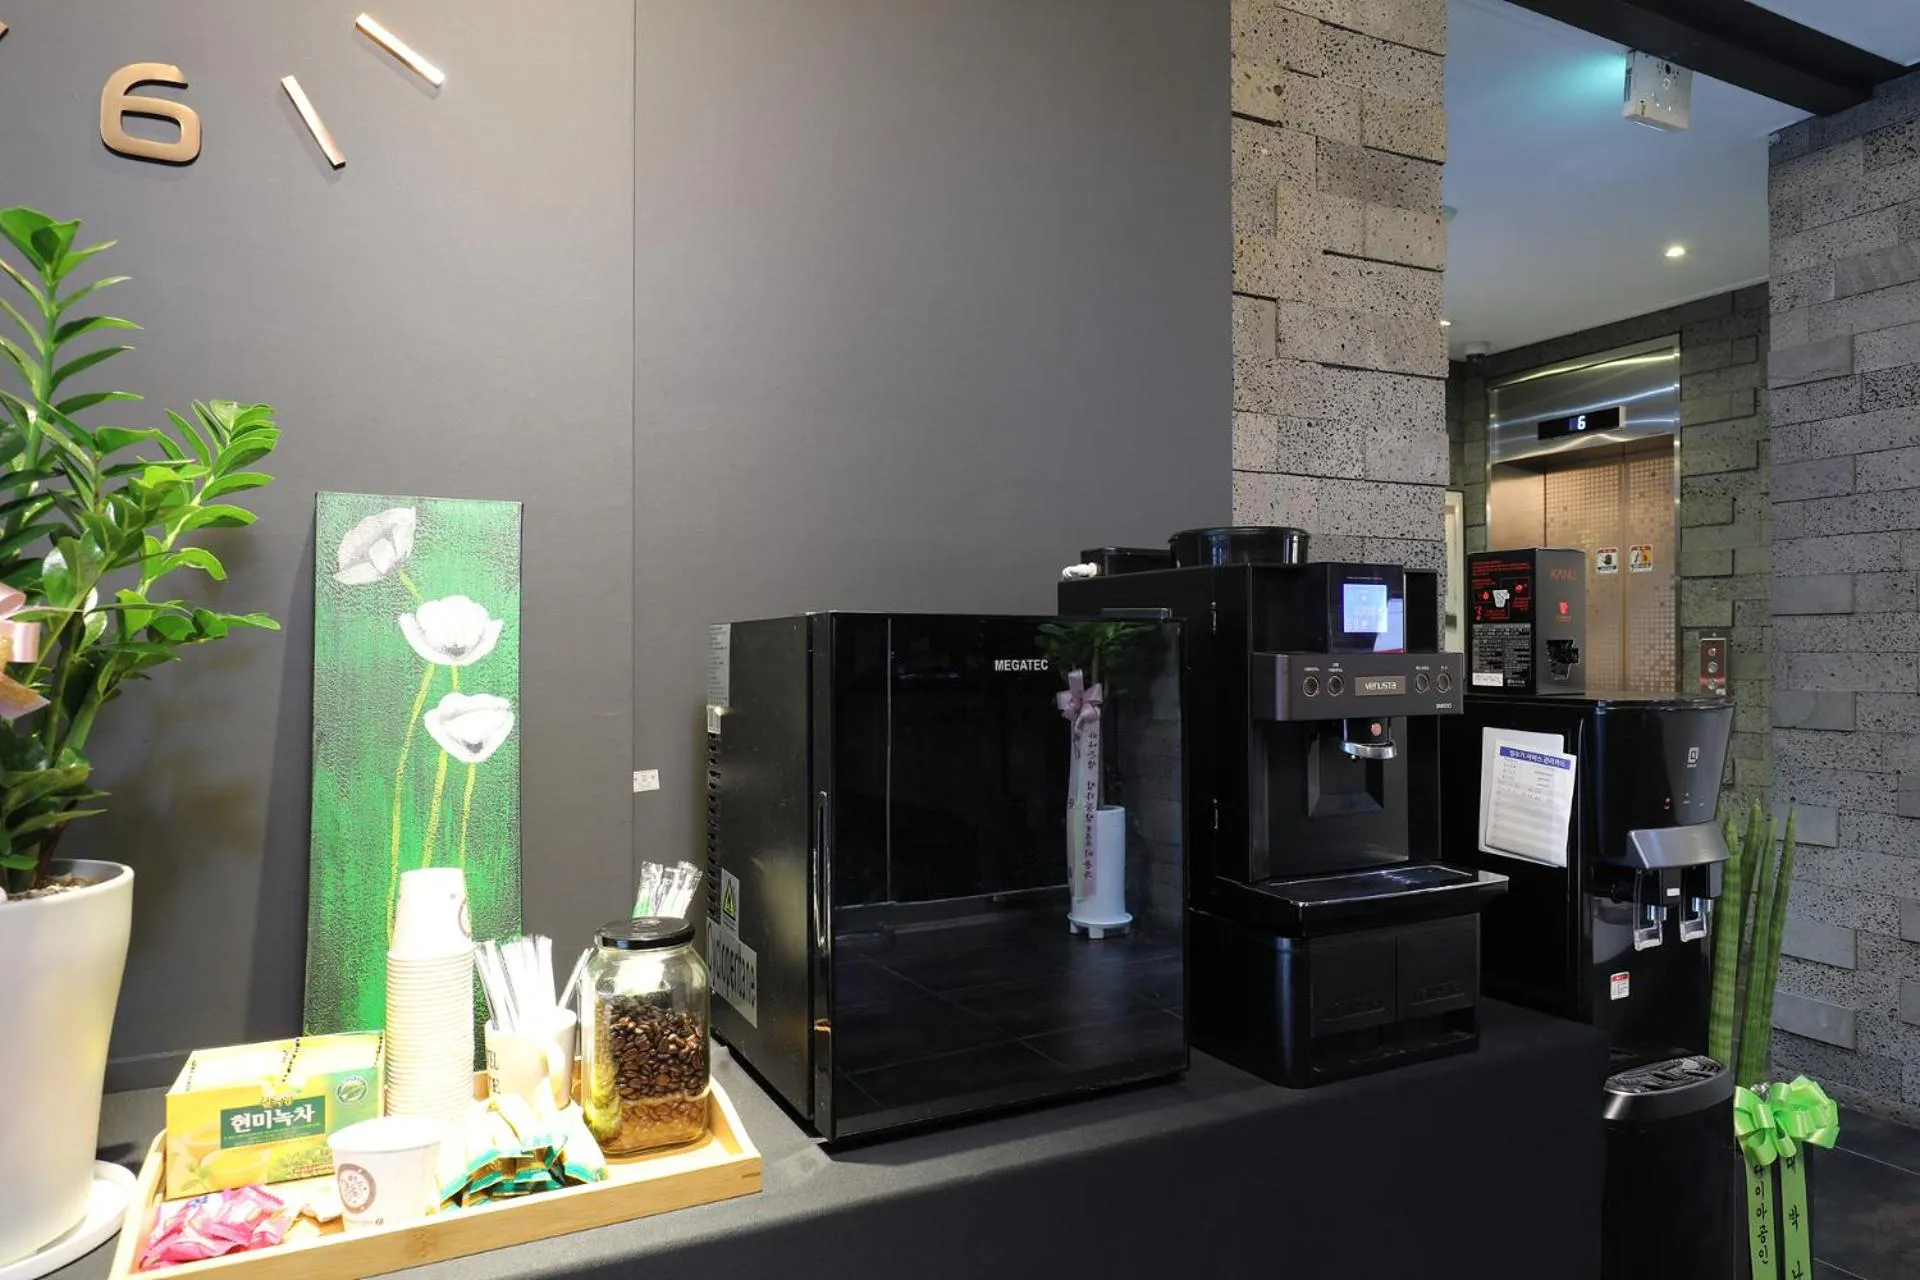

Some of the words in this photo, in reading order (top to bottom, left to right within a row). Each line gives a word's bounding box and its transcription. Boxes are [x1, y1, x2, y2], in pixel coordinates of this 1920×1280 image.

[100, 62, 202, 165] 6
[1577, 415, 1587, 430] 6
[995, 659, 1048, 671] MEGATEC
[231, 1103, 316, 1133] 현미녹차
